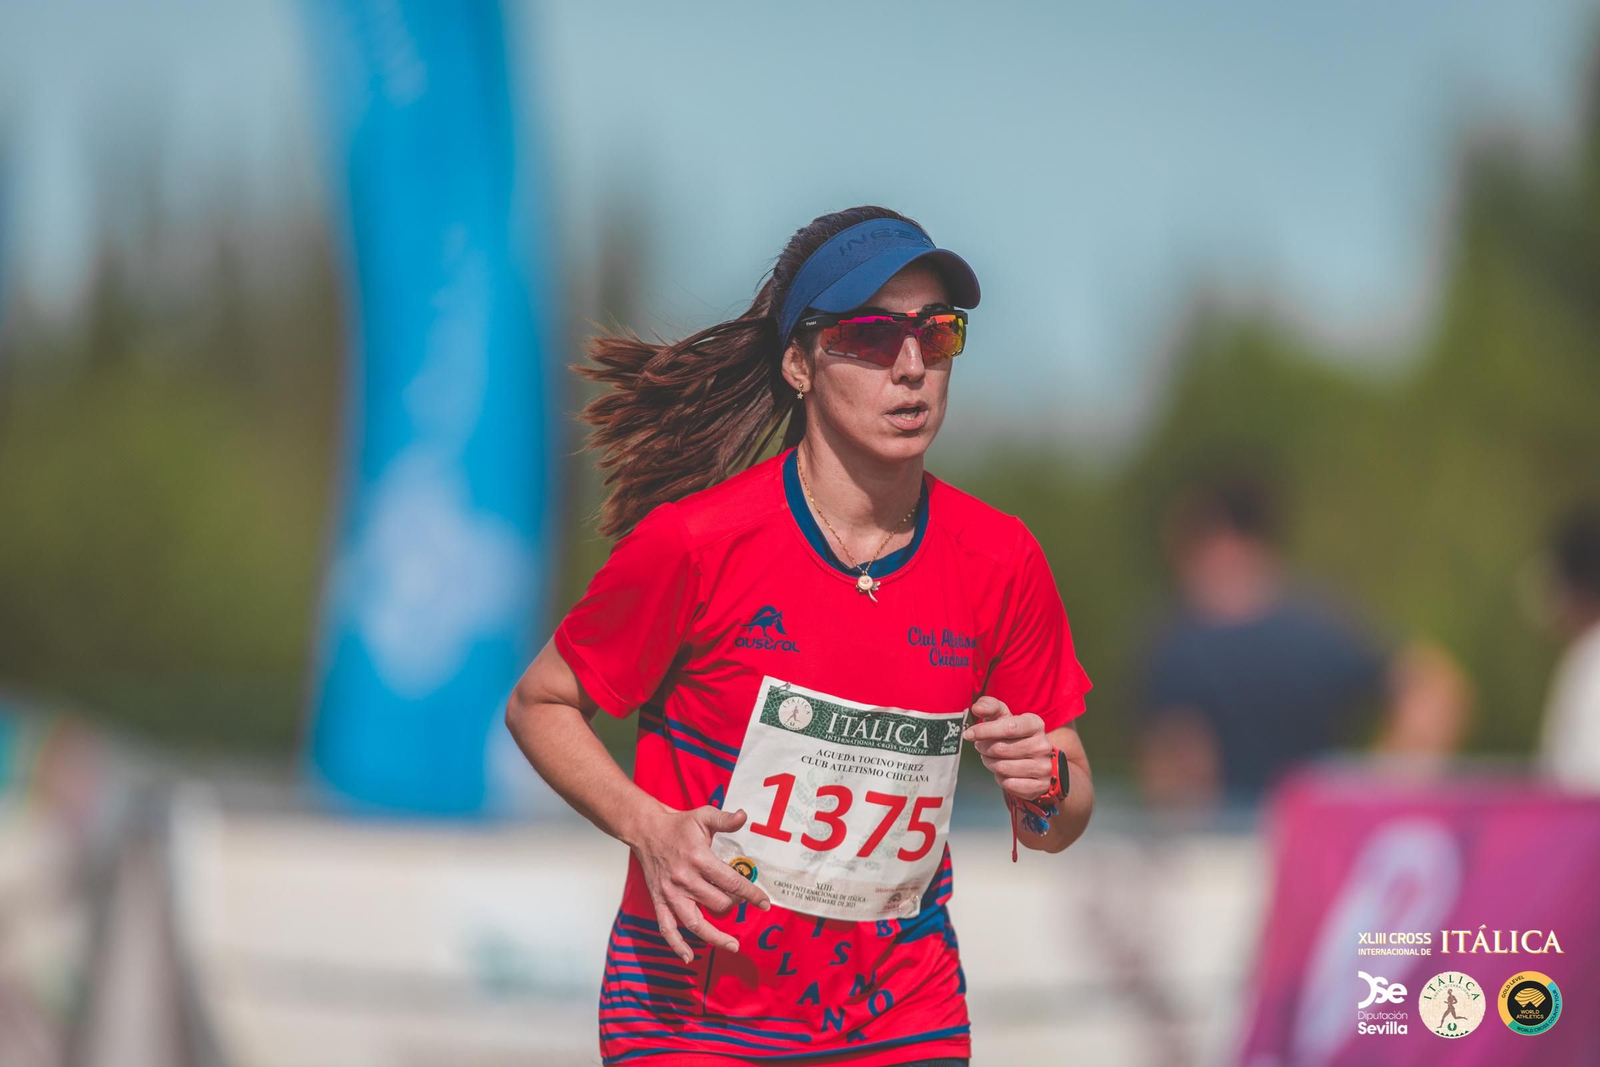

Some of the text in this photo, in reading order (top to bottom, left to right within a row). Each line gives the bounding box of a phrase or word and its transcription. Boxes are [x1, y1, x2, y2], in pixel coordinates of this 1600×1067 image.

[908, 626, 937, 647] Club
[826, 712, 929, 748] ITÁLICA
[825, 734, 875, 747] INTERNATIONAL
[877, 742, 897, 751] CROSS
[801, 755, 930, 783] CLUB ATLETISMO CHICLANA
[816, 749, 924, 772] AGUEDA TOCINO PÉREZ
[750, 772, 944, 862] 1375
[774, 881, 792, 889] CROSS
[793, 885, 838, 899] INTERNACIONAL
[805, 895, 836, 905] NOVIEMBRE
